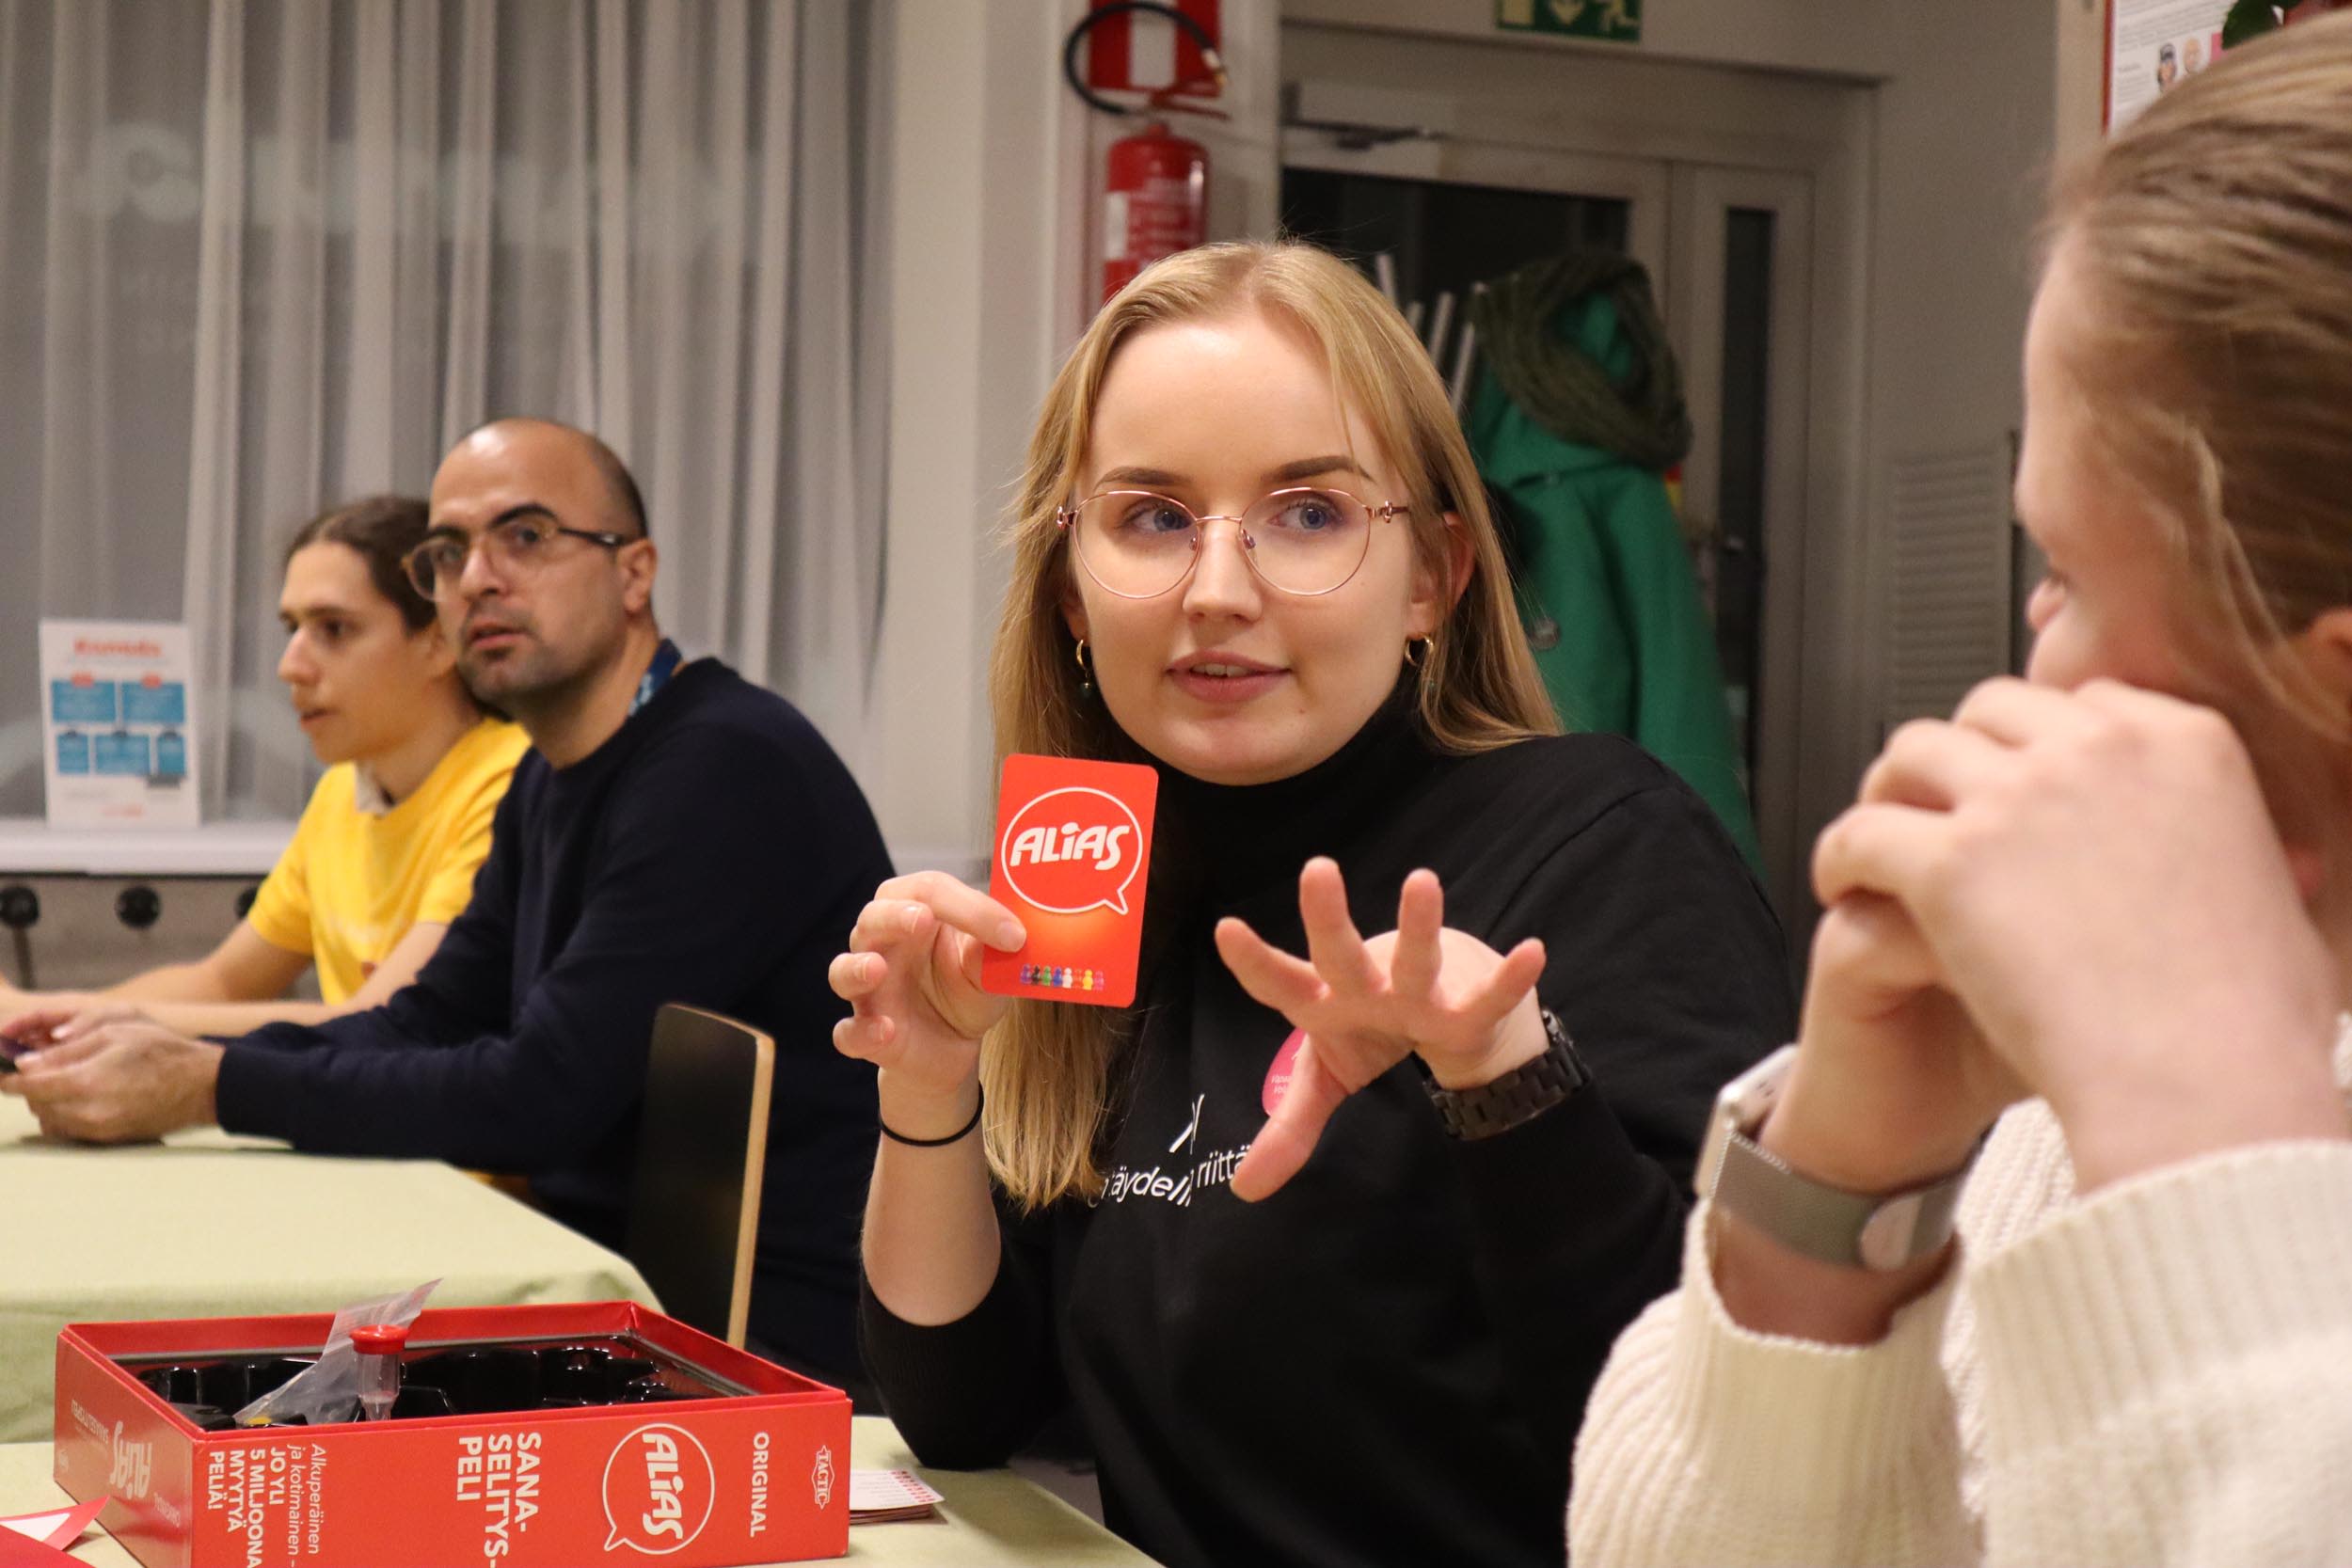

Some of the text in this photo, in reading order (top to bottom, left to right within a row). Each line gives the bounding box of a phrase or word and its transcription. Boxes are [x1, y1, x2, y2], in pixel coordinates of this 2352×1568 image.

[207, 1450, 227, 1510] PELIÄ!
[227, 1449, 246, 1532] MYYTYÄ
[269, 1447, 287, 1505] JO YLI
[287, 1444, 306, 1460] ja
[456, 1436, 484, 1501] PELI
[514, 1432, 542, 1532] SANA-
[750, 1432, 771, 1538] ORIGINAL
[817, 1453, 829, 1503] TACTIC
[246, 1449, 266, 1568] 5 MILJOONA
[288, 1465, 307, 1556] kotimainen
[306, 1444, 326, 1555] Alkuperäinen
[484, 1433, 513, 1568] SELITYS-
